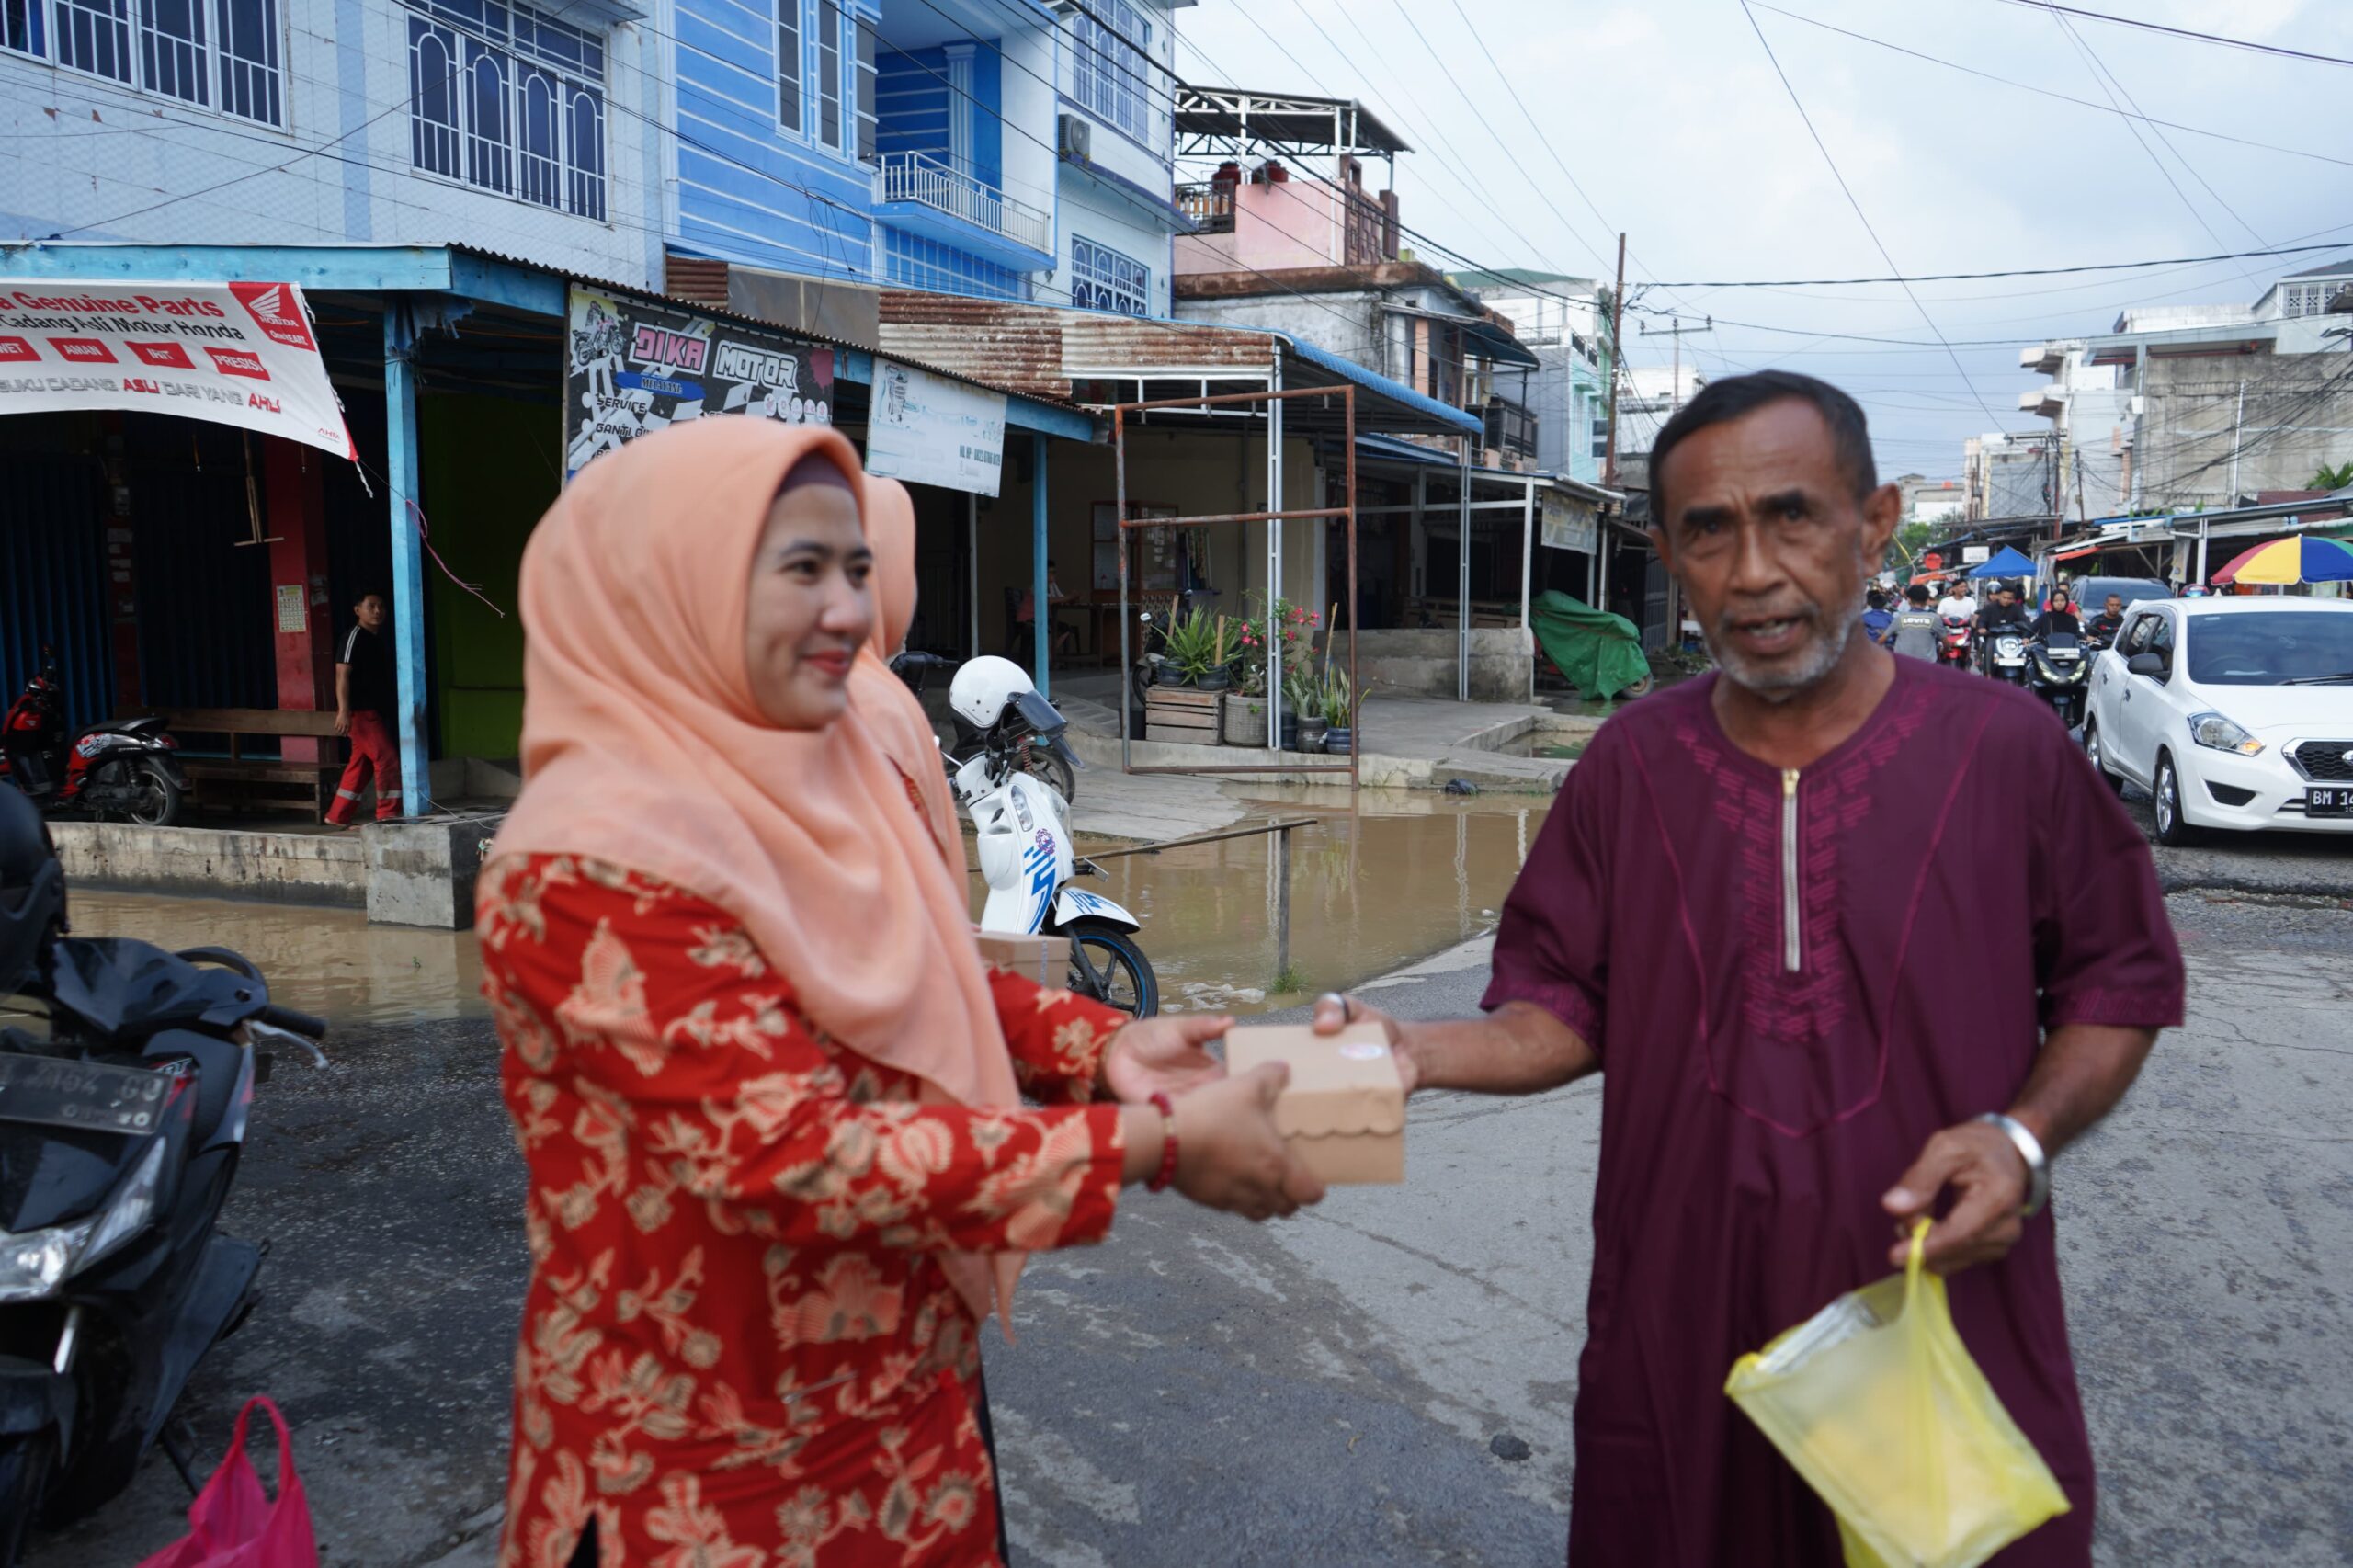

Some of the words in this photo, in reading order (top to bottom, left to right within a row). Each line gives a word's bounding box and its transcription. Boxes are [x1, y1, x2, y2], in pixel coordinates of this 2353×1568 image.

[12, 291, 141, 314] Genuine
[132, 295, 225, 318] Parts
[0, 313, 79, 333] Cadang
[72, 316, 113, 332] Asli
[108, 317, 176, 335] Motor
[173, 320, 246, 340] Honda
[63, 344, 103, 356] AMAN
[633, 326, 706, 372] DIKA
[715, 343, 797, 391] MOTOR
[213, 354, 264, 372] PRESISI
[123, 378, 160, 394] ASLI
[597, 397, 646, 414] SERVICE
[2313, 790, 2332, 805] BM
